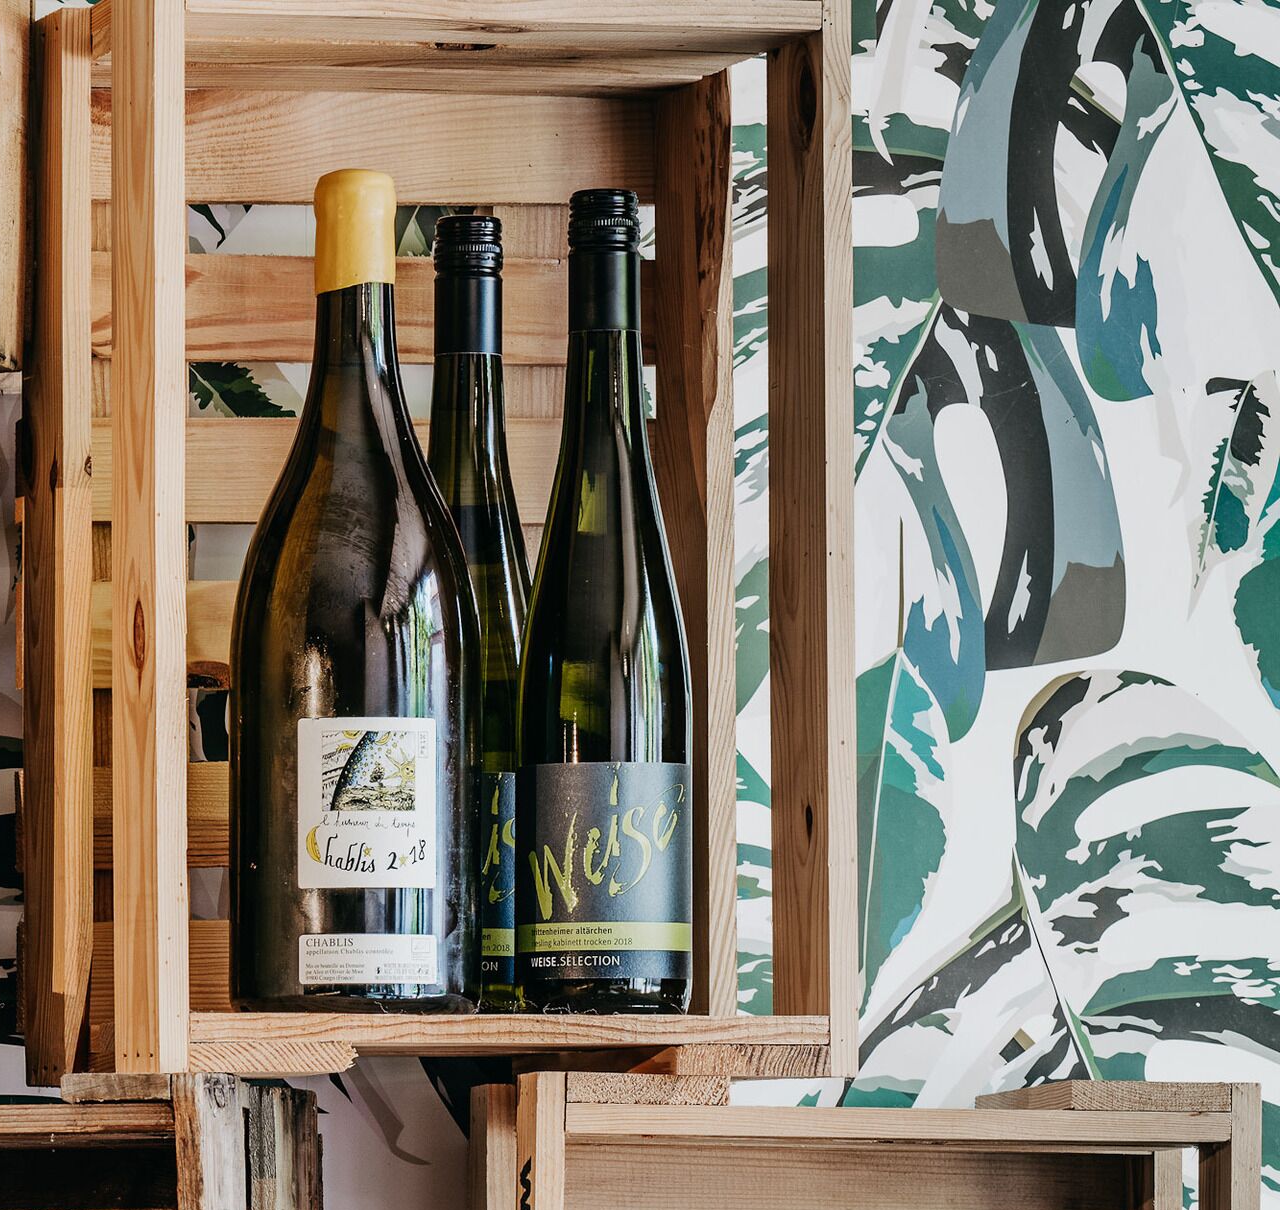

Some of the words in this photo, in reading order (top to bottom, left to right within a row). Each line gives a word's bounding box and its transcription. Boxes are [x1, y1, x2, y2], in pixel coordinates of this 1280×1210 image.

[575, 926, 612, 935] altärchen
[305, 938, 354, 948] CHABLIS
[552, 937, 582, 946] kabinett
[583, 937, 612, 946] trocken
[613, 938, 633, 946] 2018
[492, 944, 510, 952] 2018
[531, 955, 620, 968] WEISE.SELECTION
